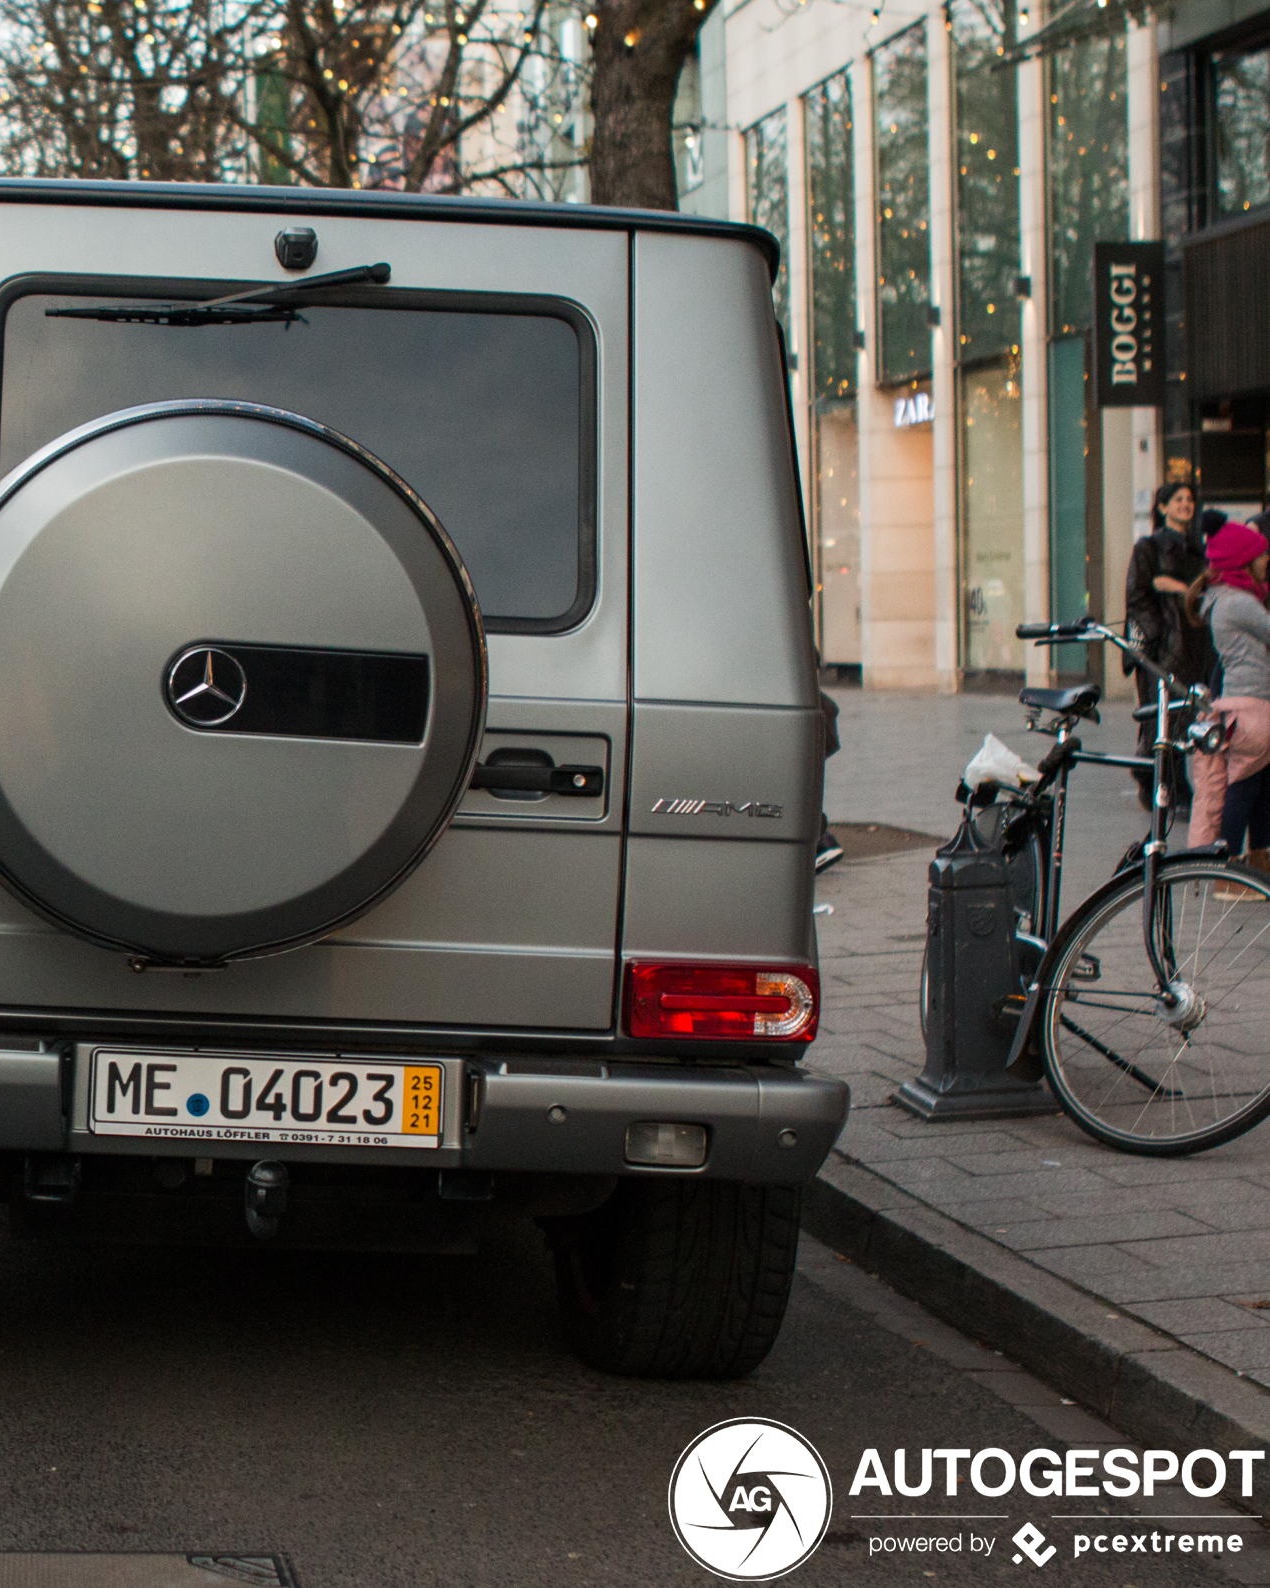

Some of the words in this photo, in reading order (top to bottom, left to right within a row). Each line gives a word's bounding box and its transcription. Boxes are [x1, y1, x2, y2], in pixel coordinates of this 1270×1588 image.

[1110, 263, 1138, 386] BOGGI
[411, 1075, 433, 1091] 25
[106, 1060, 179, 1117] ME
[220, 1066, 395, 1127] 04023
[412, 1094, 433, 1110] 12
[410, 1113, 430, 1128] 21
[145, 1127, 213, 1138] AUTOHAUS
[217, 1127, 271, 1140] LÖFFLER
[338, 1135, 351, 1143] 31
[356, 1136, 370, 1144] 18
[373, 1136, 388, 1145] 06
